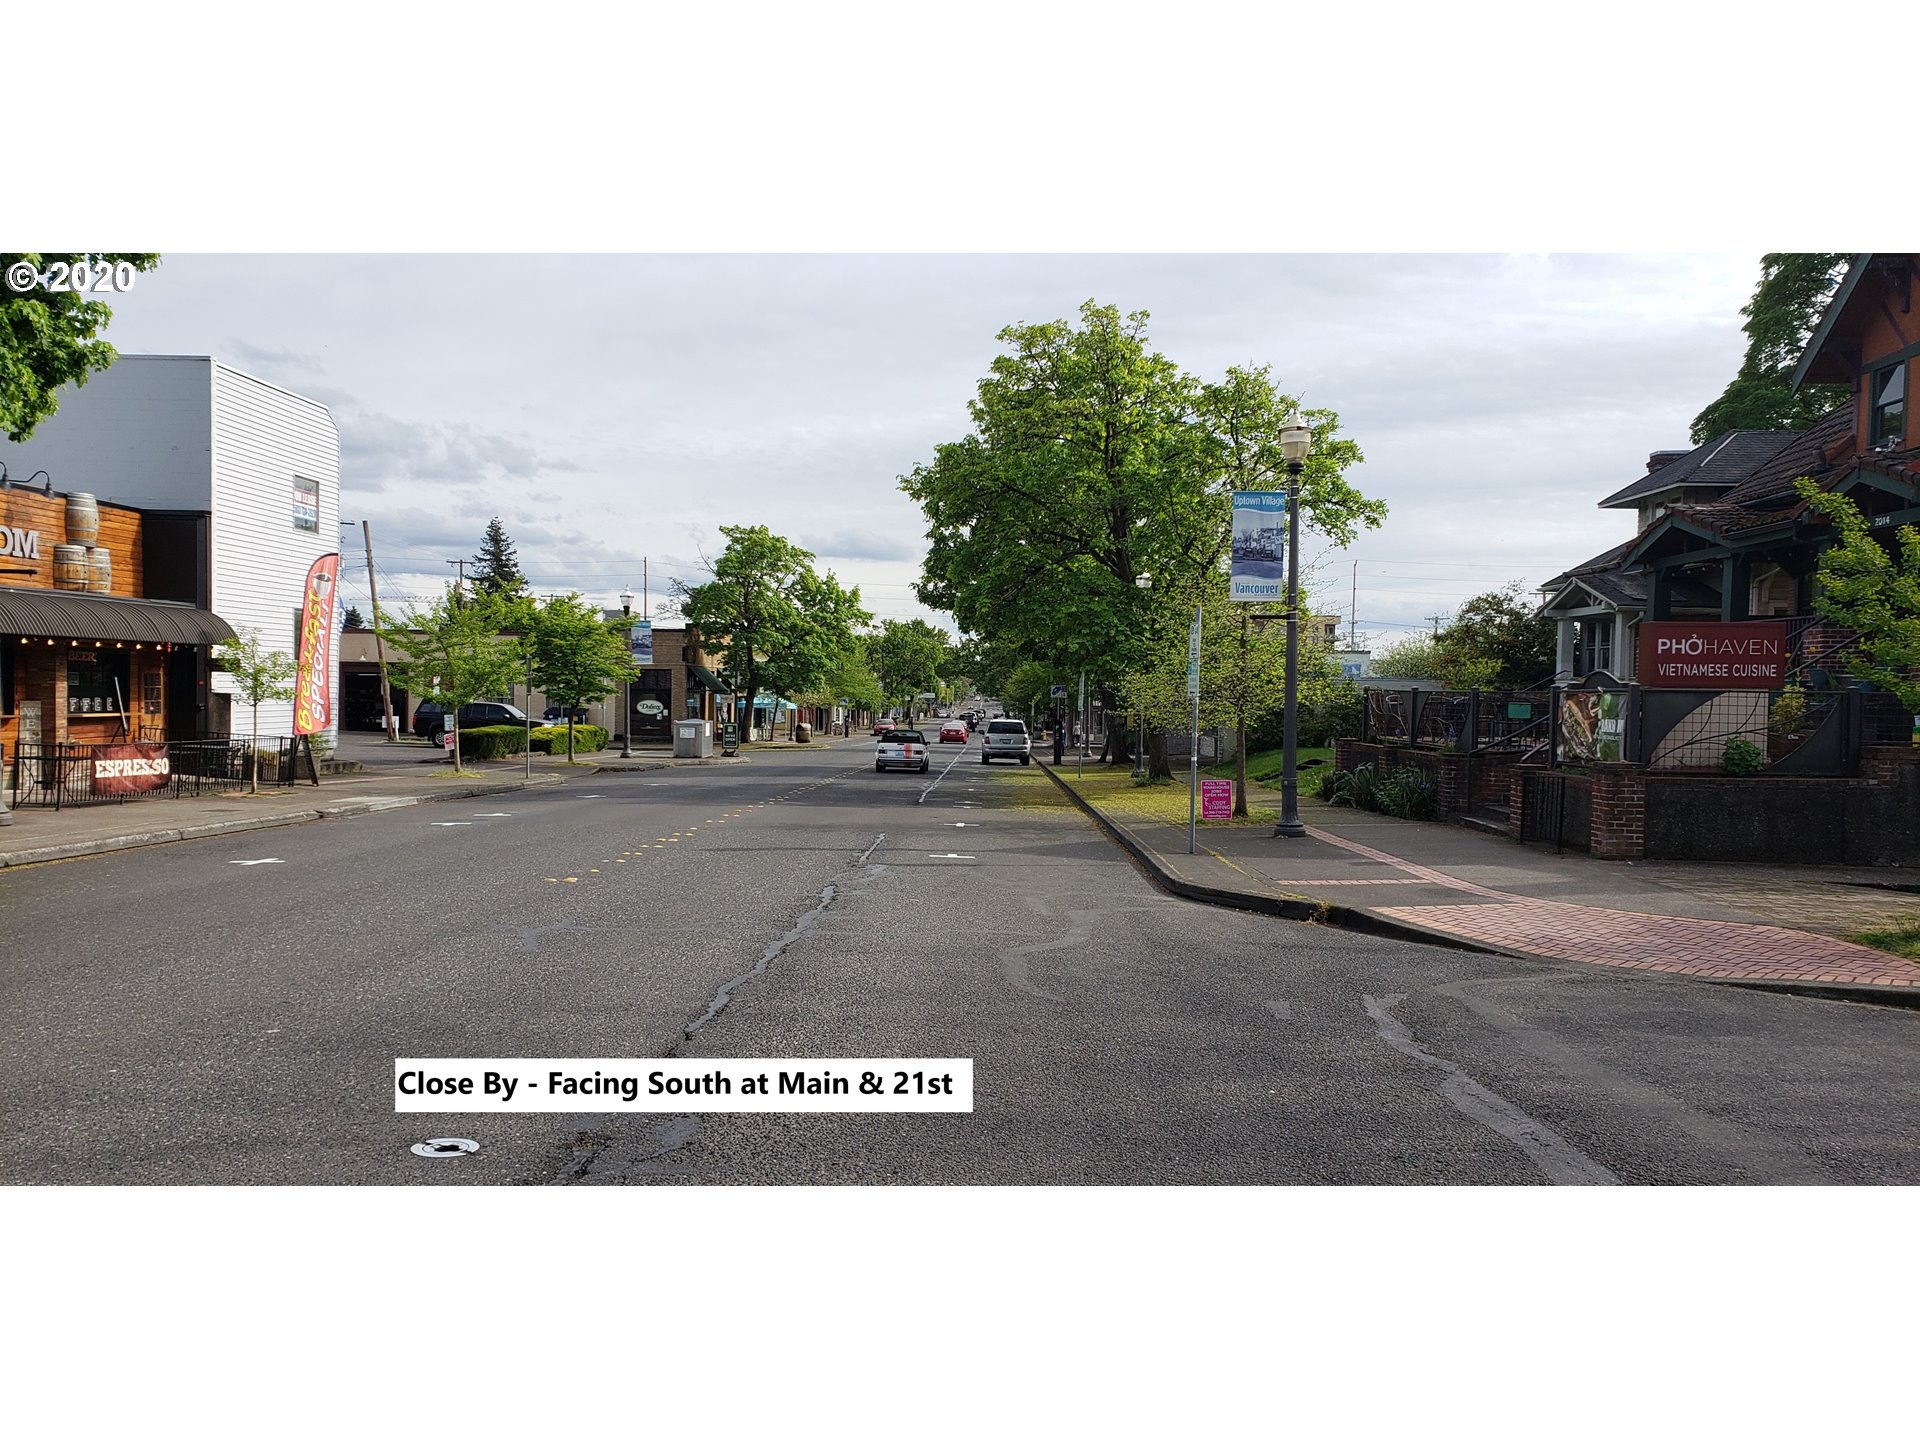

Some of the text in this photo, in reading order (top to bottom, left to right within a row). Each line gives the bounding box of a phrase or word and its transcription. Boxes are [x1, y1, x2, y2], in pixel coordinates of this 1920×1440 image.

[1234, 495, 1284, 507] Uptown Village
[1874, 515, 1890, 526] 2014
[1235, 582, 1279, 594] Vancouver
[298, 589, 322, 731] Breakfast
[1658, 663, 1777, 677] VIETNAMESE CUISINE
[94, 757, 170, 779] ESPRESSO
